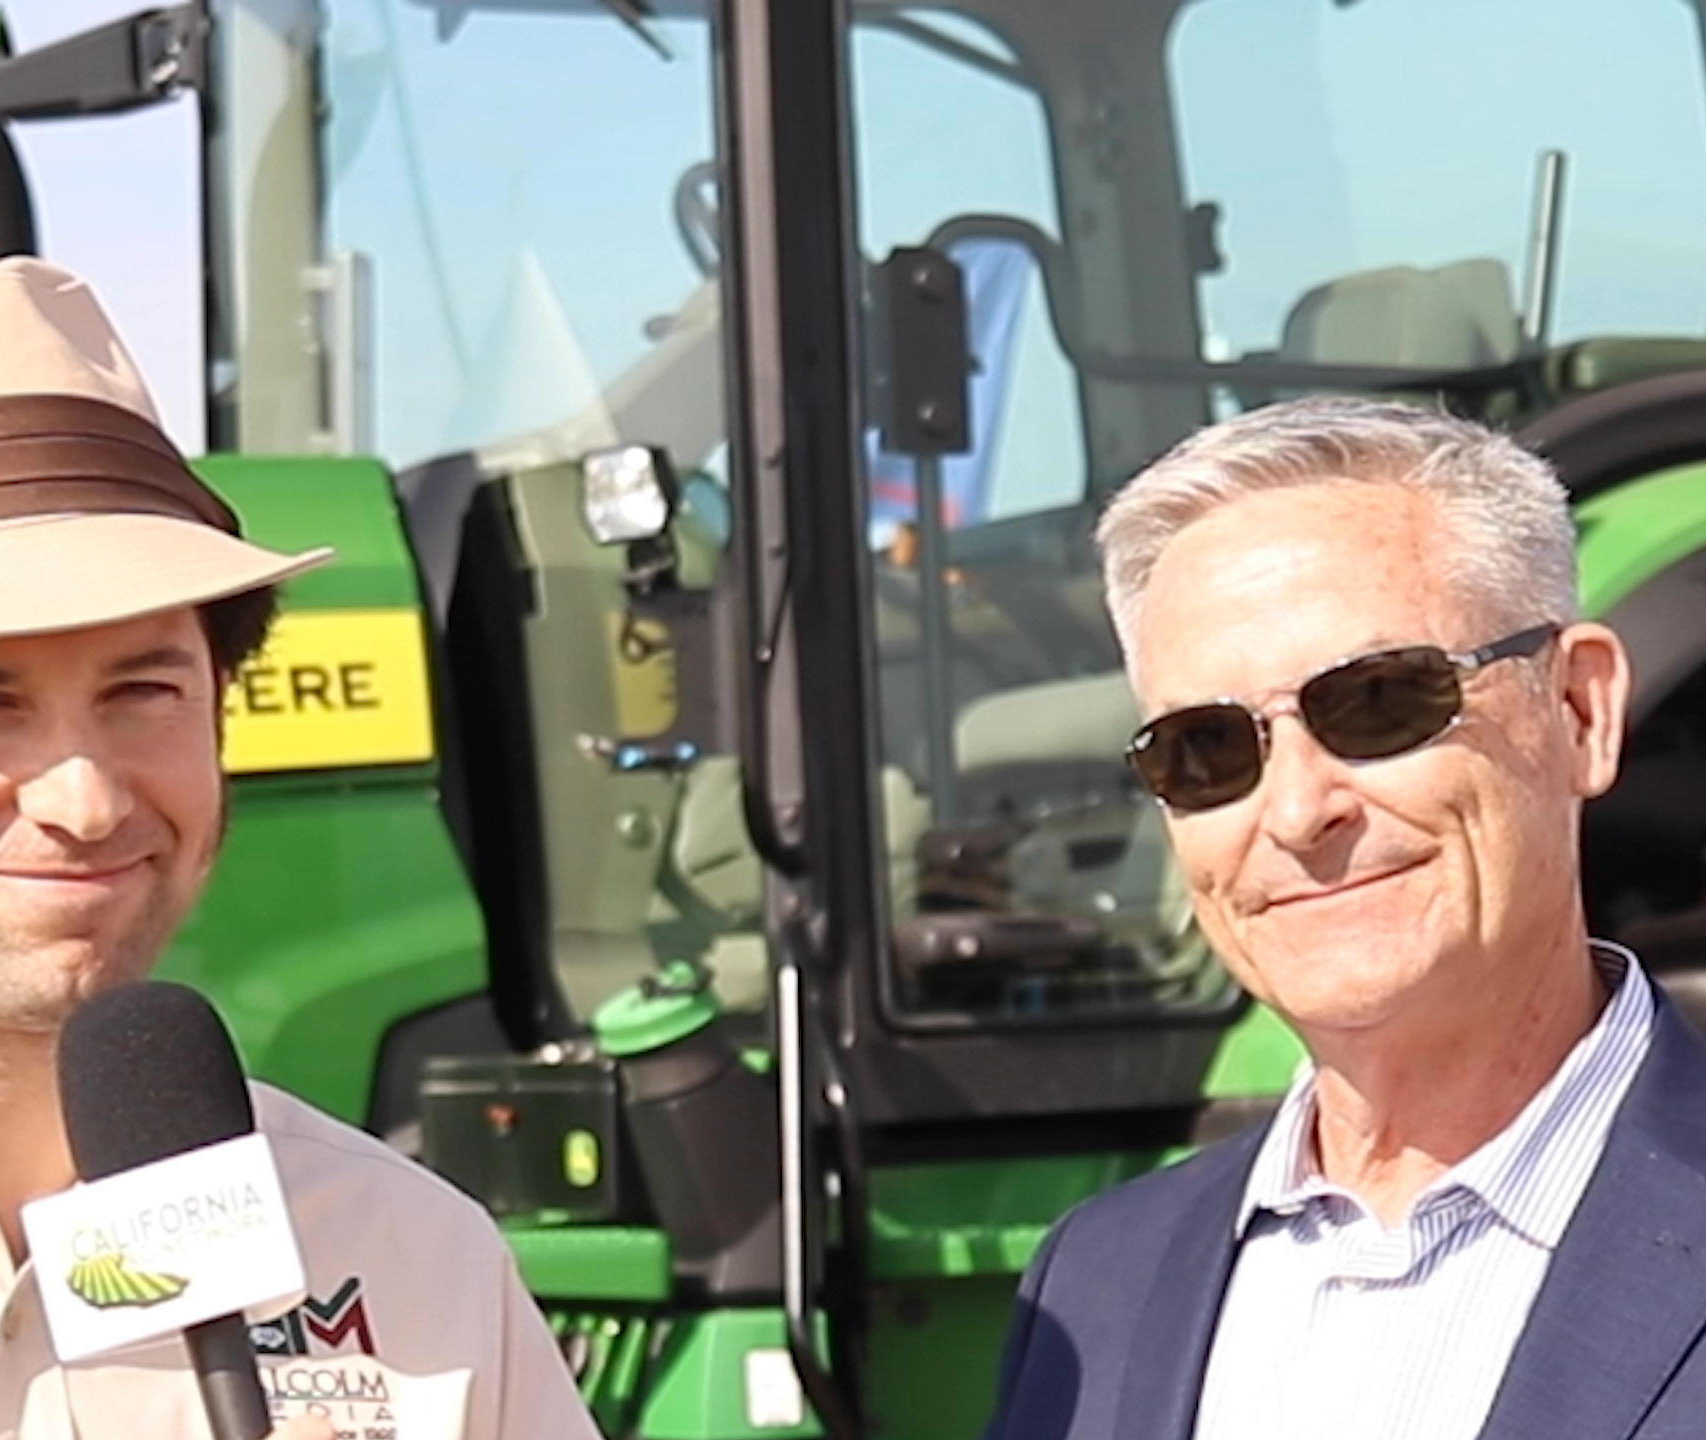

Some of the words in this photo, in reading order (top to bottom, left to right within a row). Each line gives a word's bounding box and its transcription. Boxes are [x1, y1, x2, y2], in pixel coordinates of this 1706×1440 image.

[225, 662, 382, 716] ERE
[71, 1181, 265, 1262] CALIFORNIA
[270, 1367, 389, 1401] LCOLM
[271, 1403, 396, 1421] EDIA
